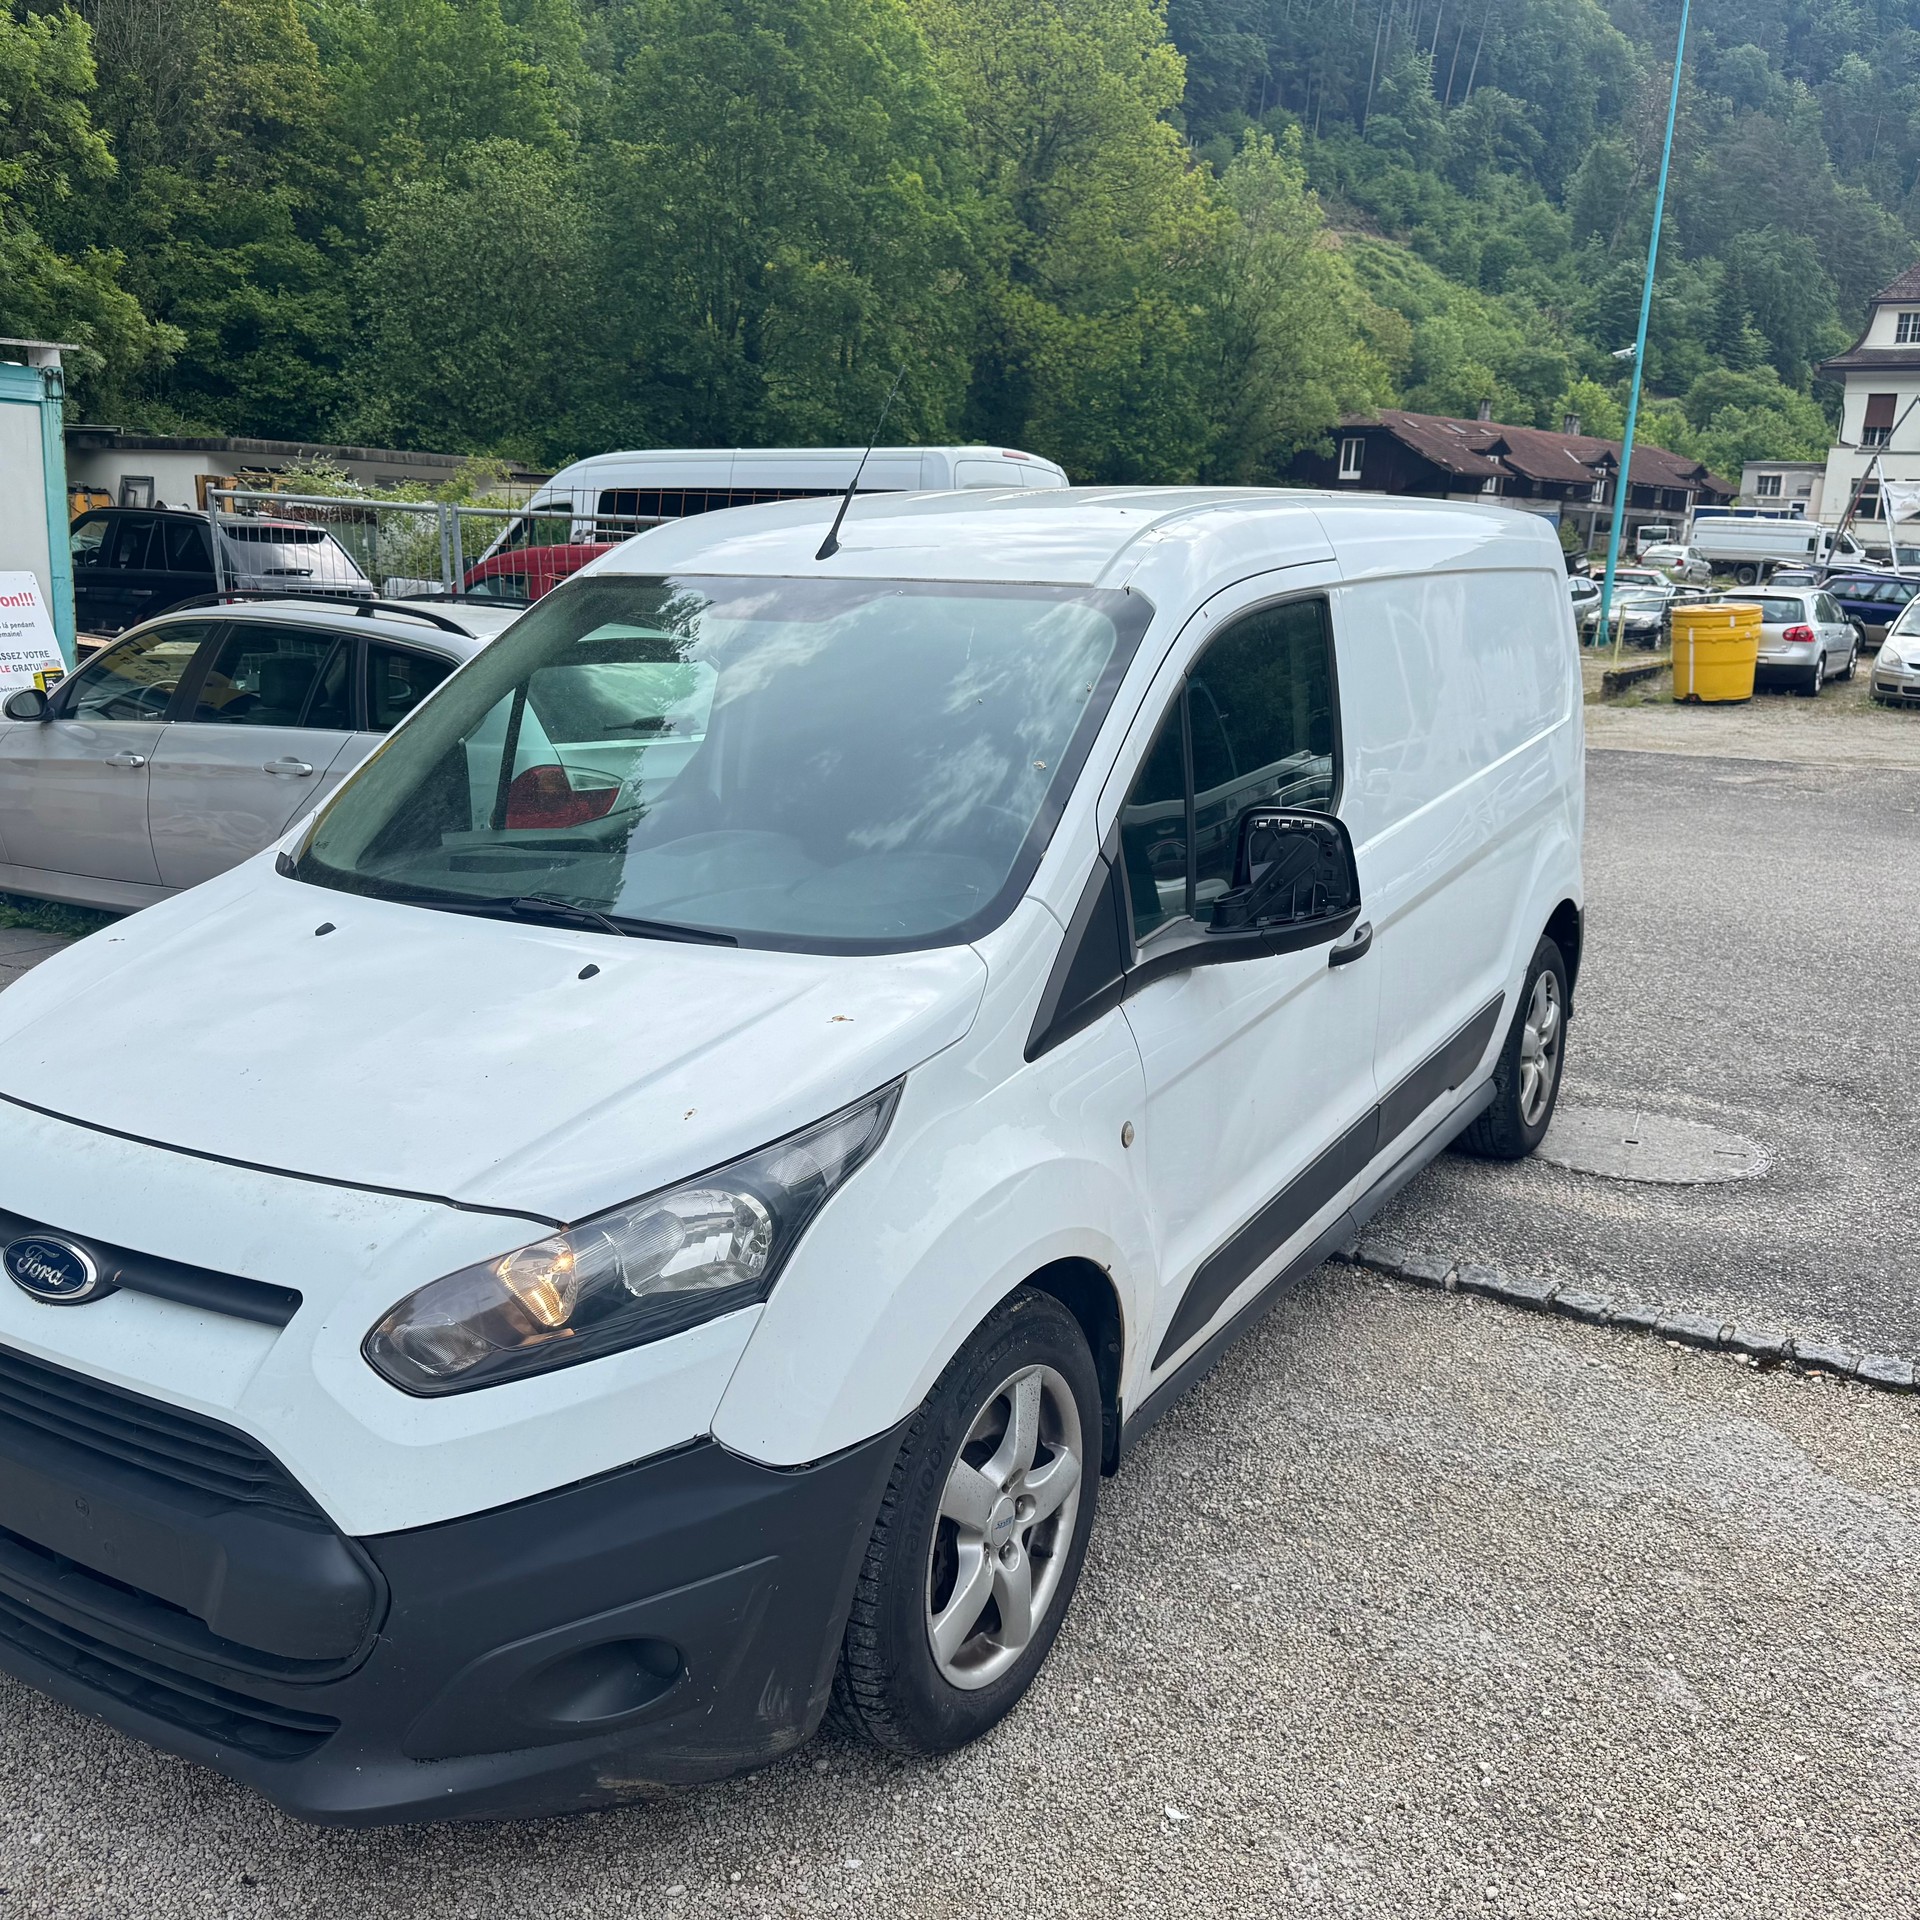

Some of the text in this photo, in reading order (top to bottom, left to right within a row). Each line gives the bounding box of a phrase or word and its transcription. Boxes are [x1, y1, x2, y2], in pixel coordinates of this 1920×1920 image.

[10, 621, 35, 630] pendant
[23, 650, 50, 659] VOTRE
[12, 663, 42, 673] GRATUI
[17, 1244, 69, 1286] Ford
